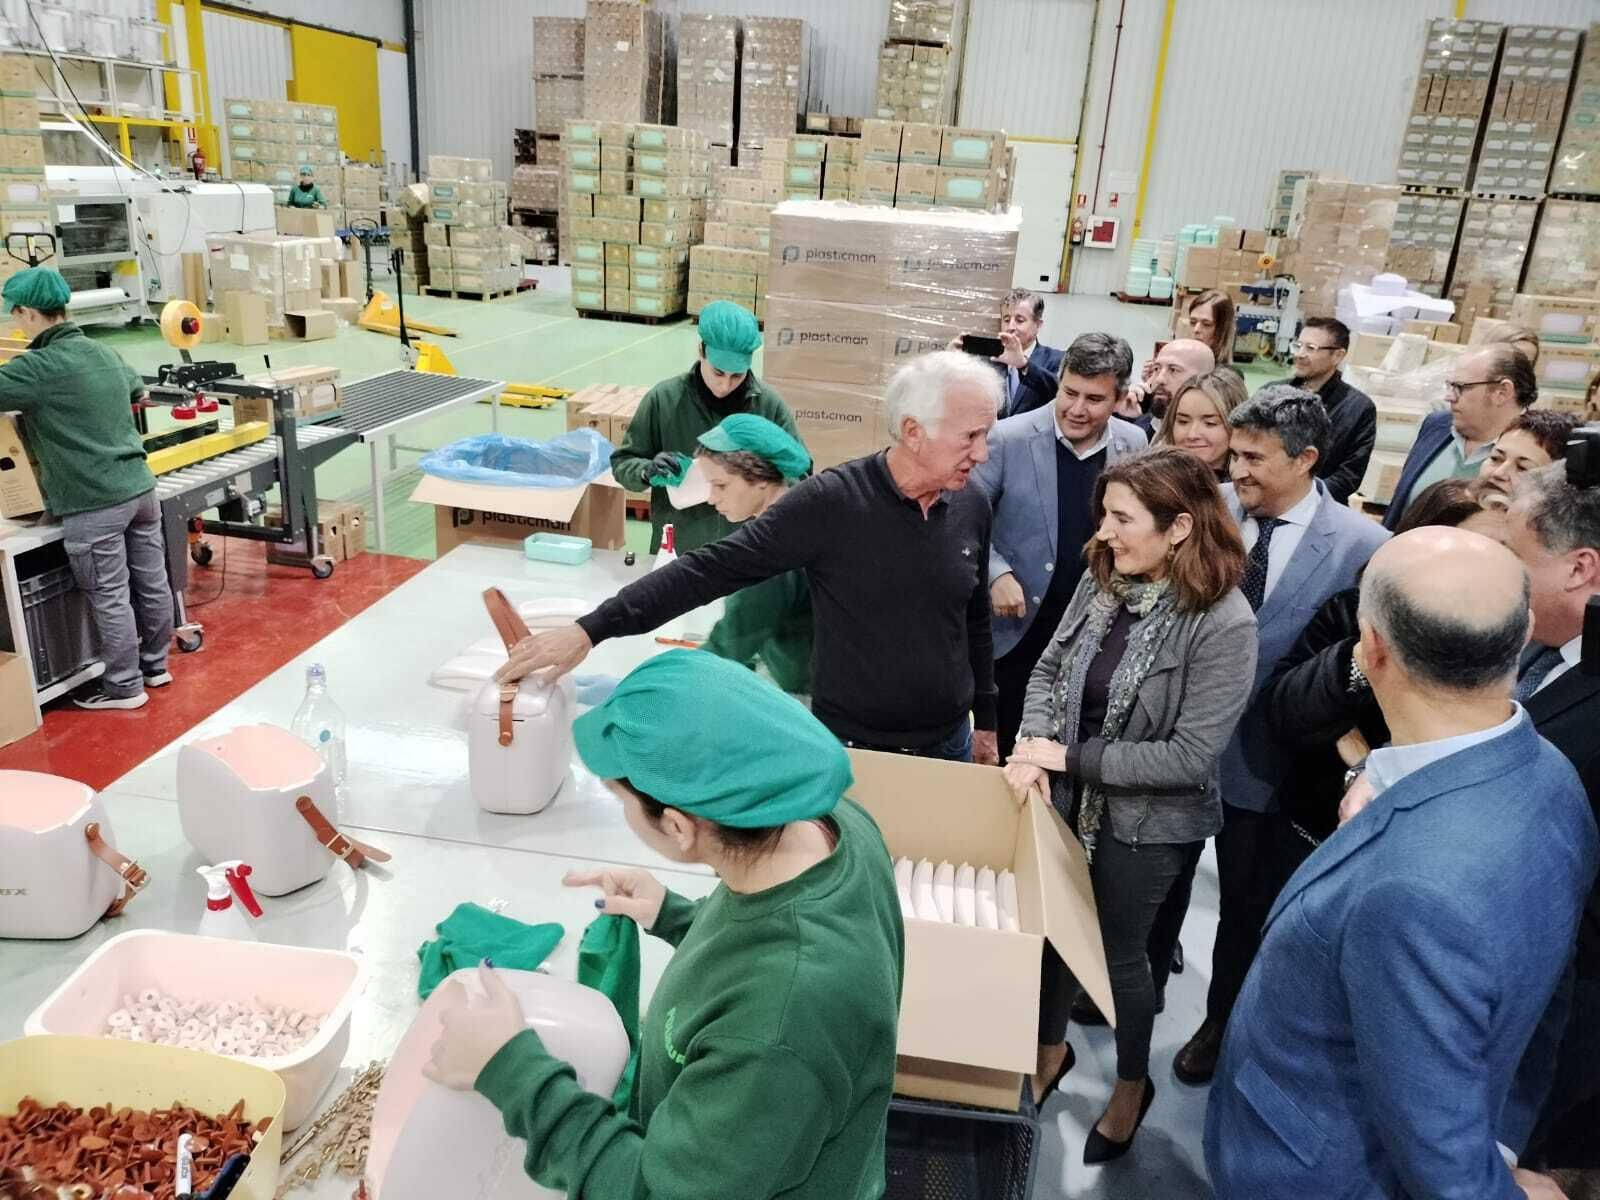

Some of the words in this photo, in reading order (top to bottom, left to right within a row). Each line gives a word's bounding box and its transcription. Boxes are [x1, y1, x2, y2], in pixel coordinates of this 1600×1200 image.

[805, 248, 876, 264] plasticman
[800, 332, 868, 345] plasticman
[795, 409, 862, 423] plasticman
